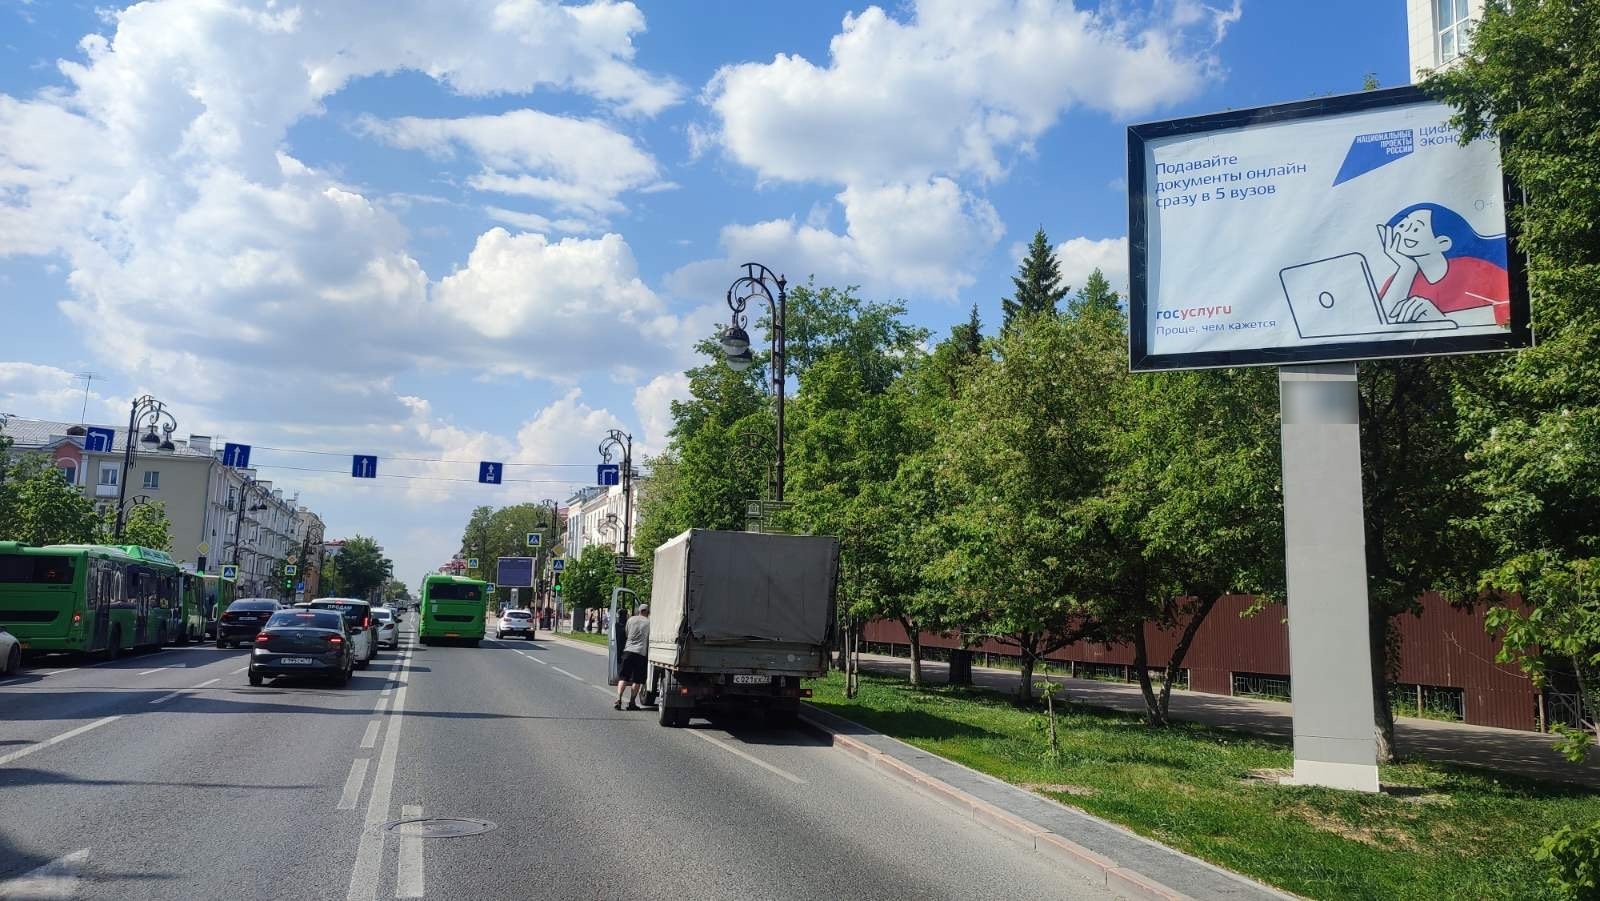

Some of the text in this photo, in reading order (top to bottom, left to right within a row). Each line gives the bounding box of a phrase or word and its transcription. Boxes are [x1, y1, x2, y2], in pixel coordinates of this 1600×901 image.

[1356, 129, 1414, 144] НАЦИОНАЛЬНЫЕ
[1380, 137, 1413, 149] ПРОЕКТЫ
[1386, 146, 1413, 156] РОССИИ
[1155, 154, 1238, 176] Подавайте
[1155, 162, 1307, 194] документы онлайн
[1155, 184, 1276, 210] сразу в 5 вузов
[1156, 304, 1233, 321] госуслуги
[1156, 319, 1276, 337] Проще, чем кажется
